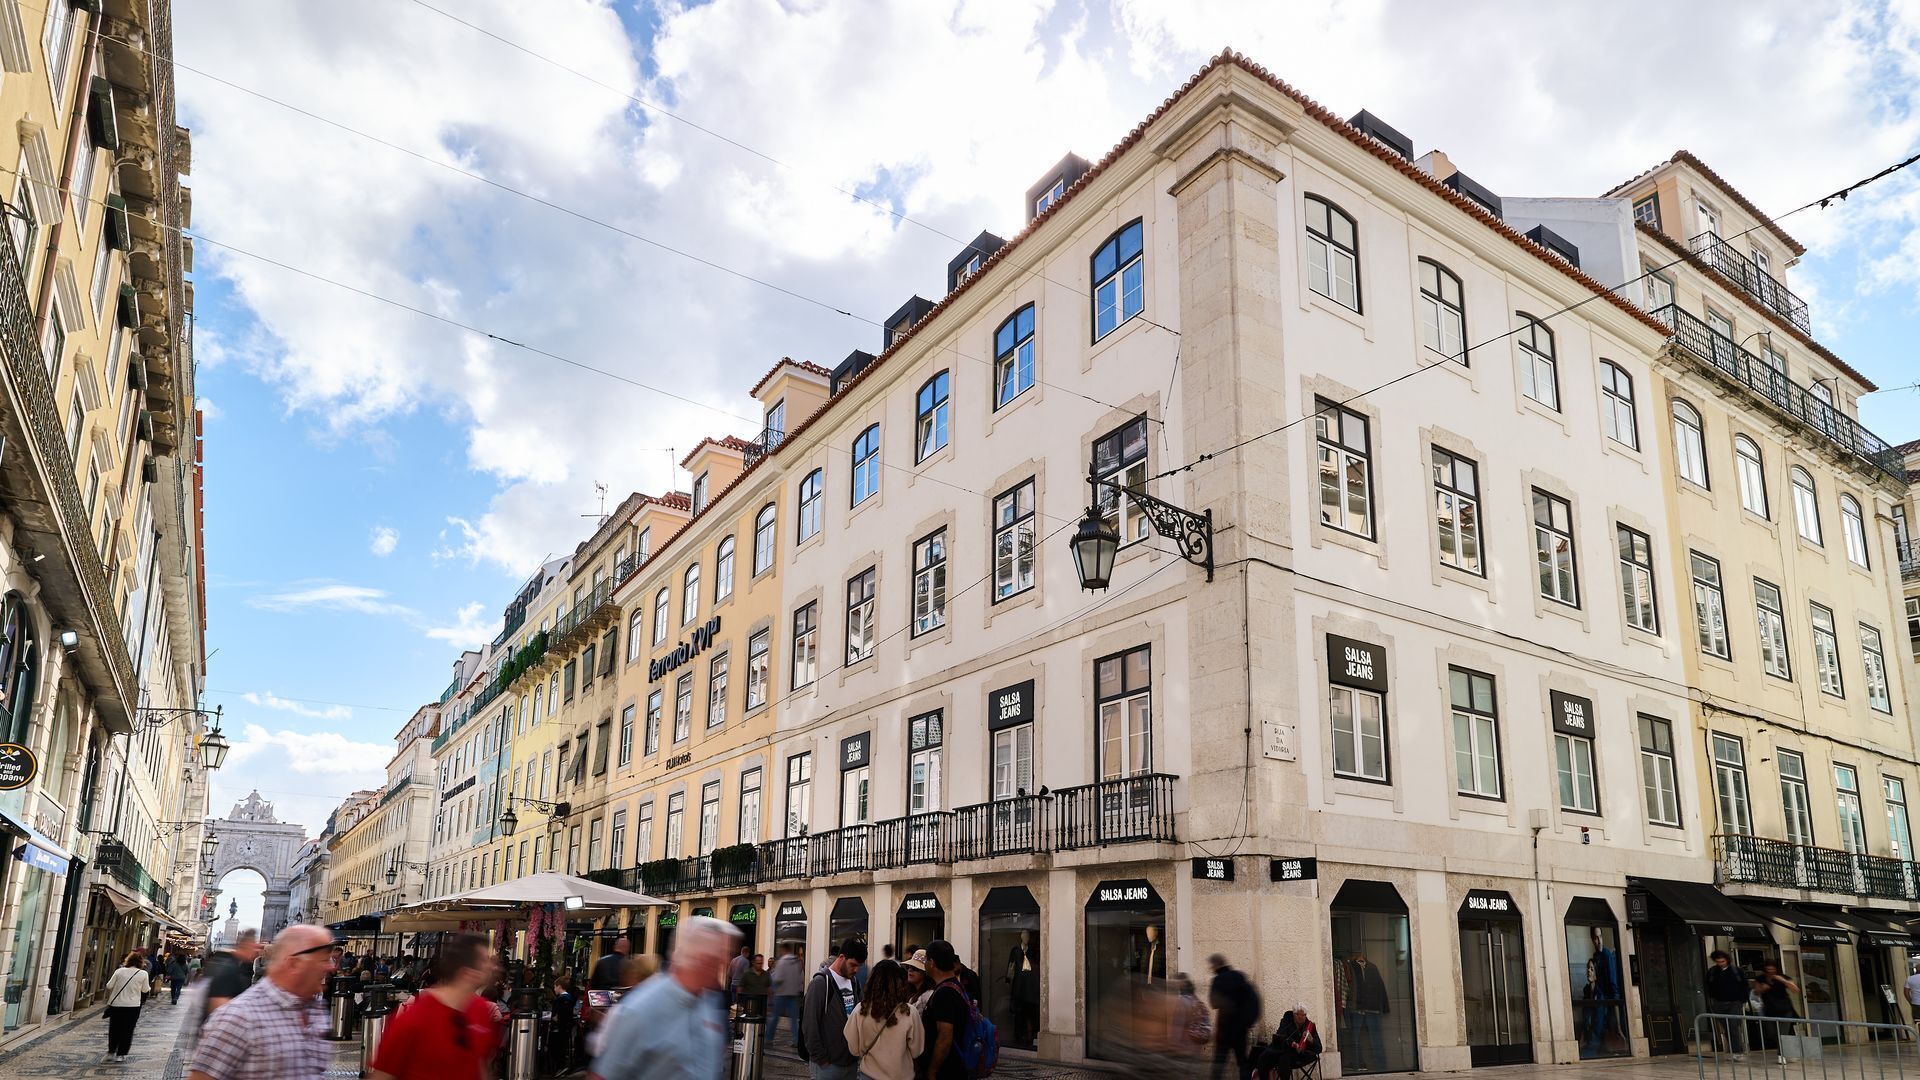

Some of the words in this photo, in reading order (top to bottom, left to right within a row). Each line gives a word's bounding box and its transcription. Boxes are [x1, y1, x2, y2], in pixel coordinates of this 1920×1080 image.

[1344, 646, 1372, 666] SALSA
[1345, 661, 1374, 681] JEANS
[999, 691, 1021, 708] SALSA
[999, 703, 1021, 720] JEANS
[1563, 700, 1584, 717] SALSA
[1565, 713, 1585, 729] JEANS
[847, 740, 861, 753] SALSA
[846, 750, 862, 763] JEANS
[0, 762, 21, 771] rilled
[1206, 860, 1224, 870] SALSA
[1282, 860, 1301, 871] SALSA
[1206, 869, 1225, 879] JEANS
[1282, 869, 1302, 879] JEANS
[1100, 888, 1123, 901] SALSA
[1123, 886, 1148, 900] JEANS
[906, 899, 921, 910] SALSA
[920, 898, 936, 909] JEANS
[1468, 896, 1488, 910] SALSA
[1488, 898, 1508, 911] JEANS
